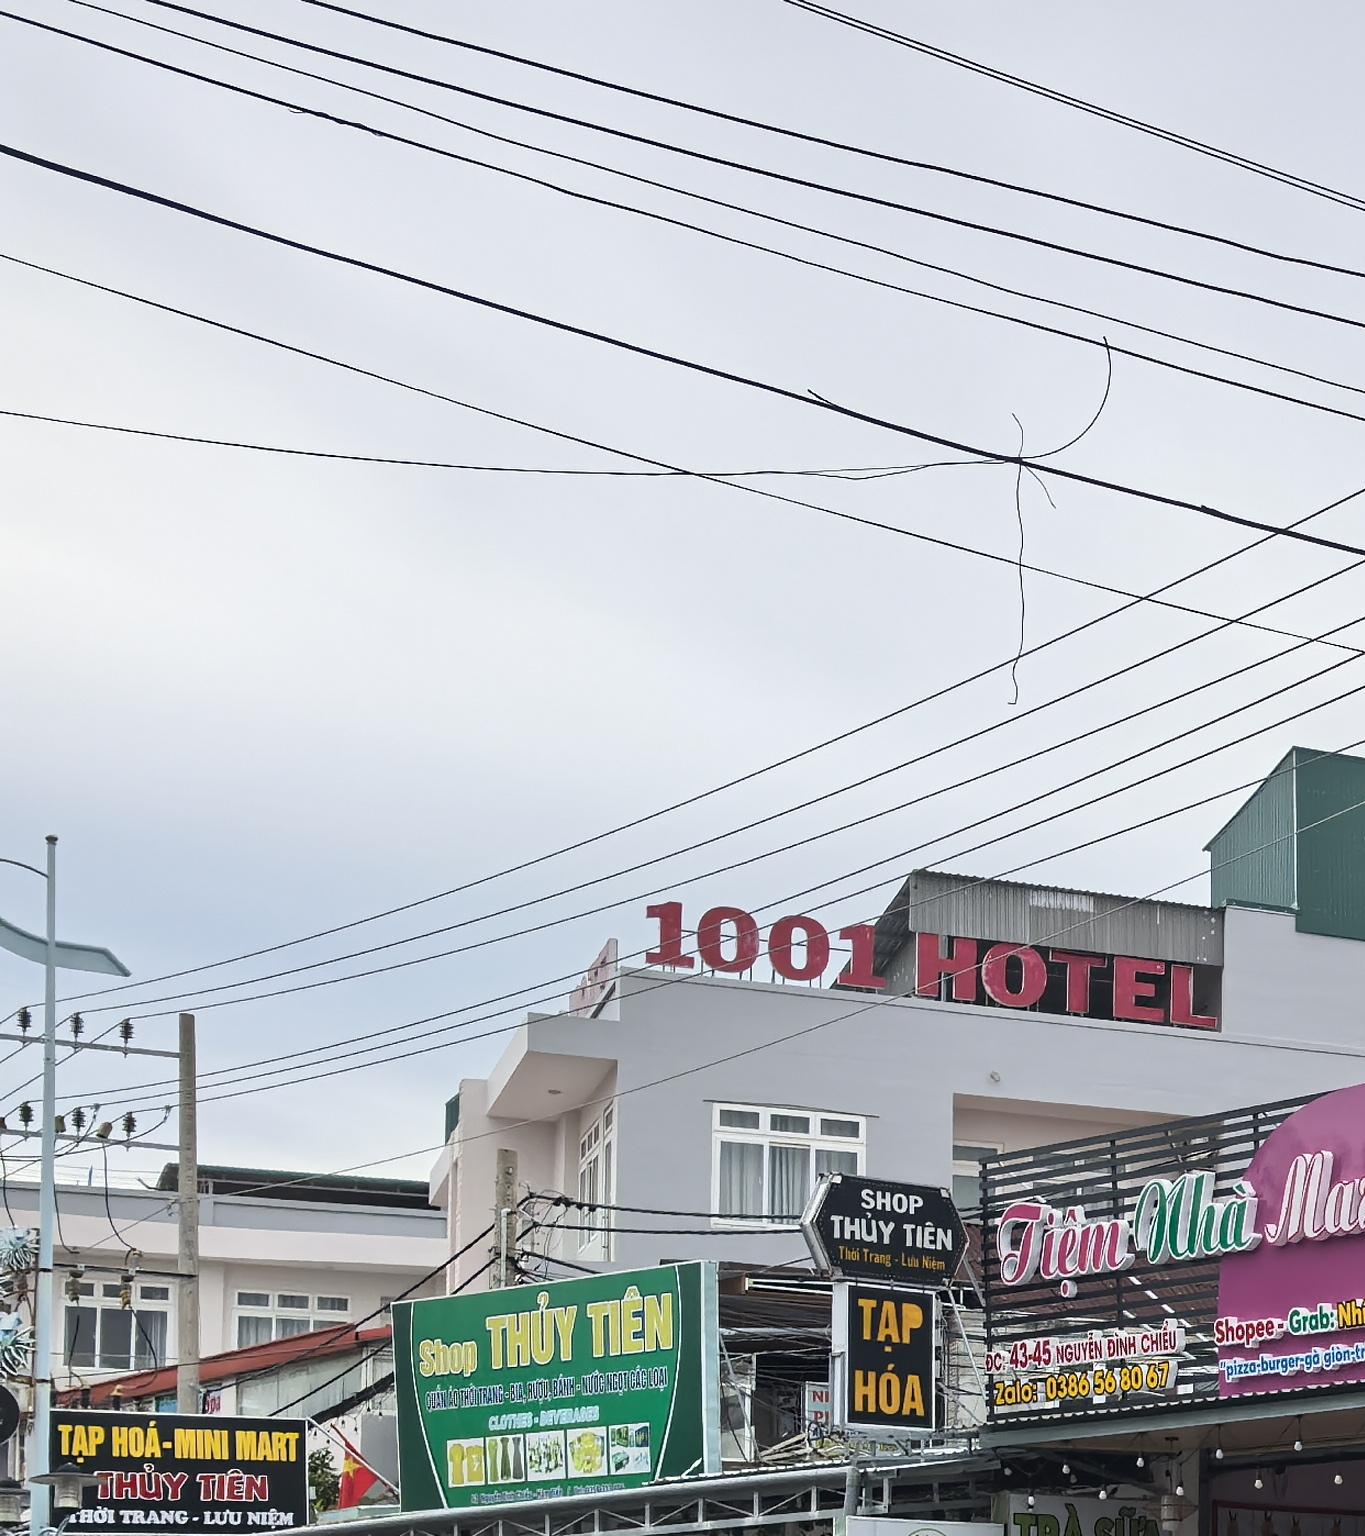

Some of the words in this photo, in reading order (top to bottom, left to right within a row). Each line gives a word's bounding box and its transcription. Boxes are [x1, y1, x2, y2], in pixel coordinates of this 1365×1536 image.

[644, 901, 887, 990] 1001
[916, 931, 1218, 1030] HOTEL
[860, 1188, 924, 1214] SHOP
[830, 1212, 894, 1244] THỦY
[903, 1222, 953, 1250] TIÊN
[996, 1201, 1134, 1298] Tiệm
[1134, 1170, 1262, 1264] Nhà
[420, 1339, 477, 1377] Shop
[486, 1292, 577, 1370] THỦY
[587, 1286, 673, 1358] TIÊN
[858, 1298, 924, 1352] TẠP
[1010, 1338, 1050, 1368] 43-45
[1056, 1330, 1102, 1364] NGUYỄN
[1108, 1332, 1136, 1357] ĐÌNH
[1141, 1320, 1176, 1353] CHIỂU
[1214, 1317, 1275, 1347] Shopee
[1288, 1307, 1334, 1334] Grab:
[854, 1363, 925, 1416] HÓA
[994, 1381, 1036, 1405] Zalo:
[1046, 1372, 1089, 1400] 0386
[1094, 1369, 1116, 1395] 56
[1120, 1364, 1142, 1392] 80
[1146, 1361, 1170, 1389] 67
[488, 1411, 533, 1431] CLOTHES
[58, 1424, 104, 1463] TẠP
[236, 1430, 299, 1462] MART
[94, 1464, 187, 1501] THỦY
[196, 1469, 269, 1502] TIÊN
[120, 1510, 188, 1524] TRANG
[204, 1511, 242, 1525] LƯU
[247, 1508, 294, 1529] NIỆM
